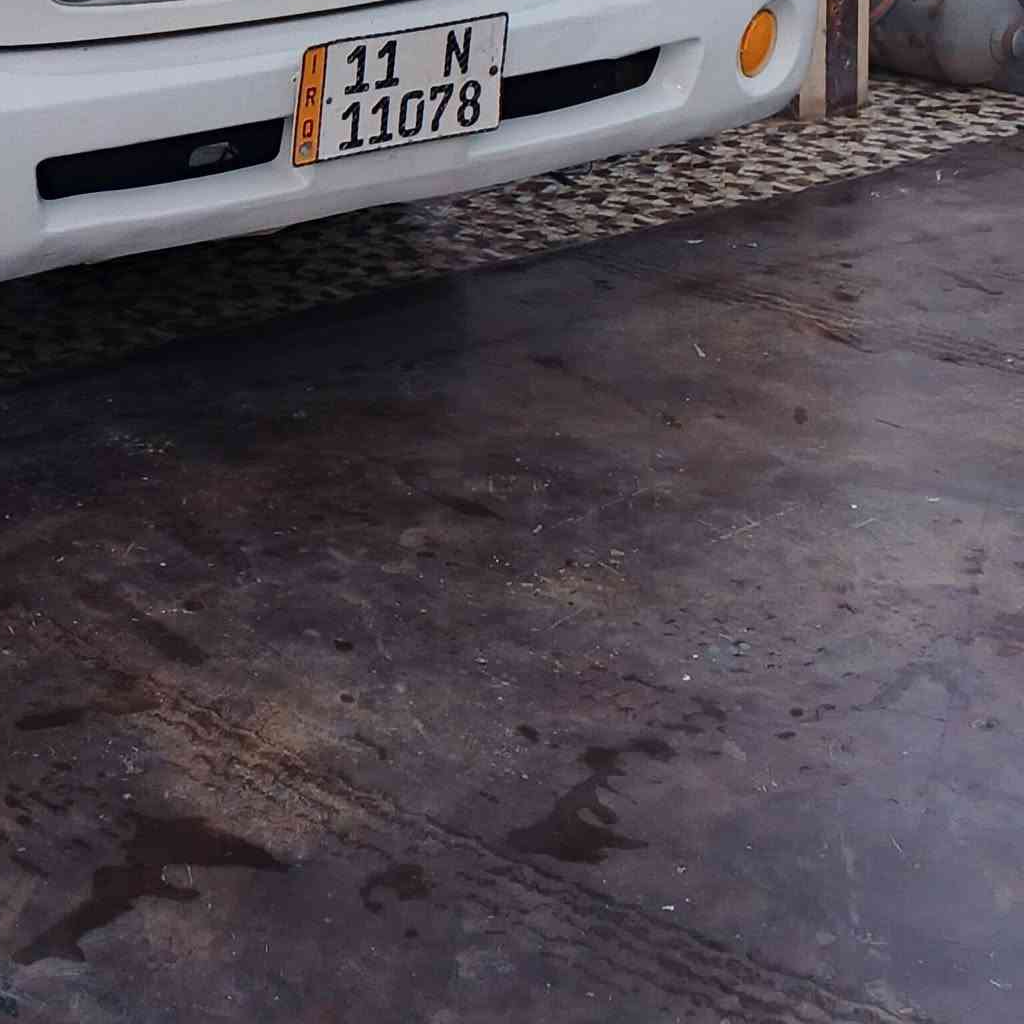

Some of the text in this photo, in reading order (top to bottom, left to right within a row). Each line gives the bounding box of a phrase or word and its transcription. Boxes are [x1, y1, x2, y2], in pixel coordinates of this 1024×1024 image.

[344, 27, 473, 96] 11 N
[339, 79, 482, 151] 11078
